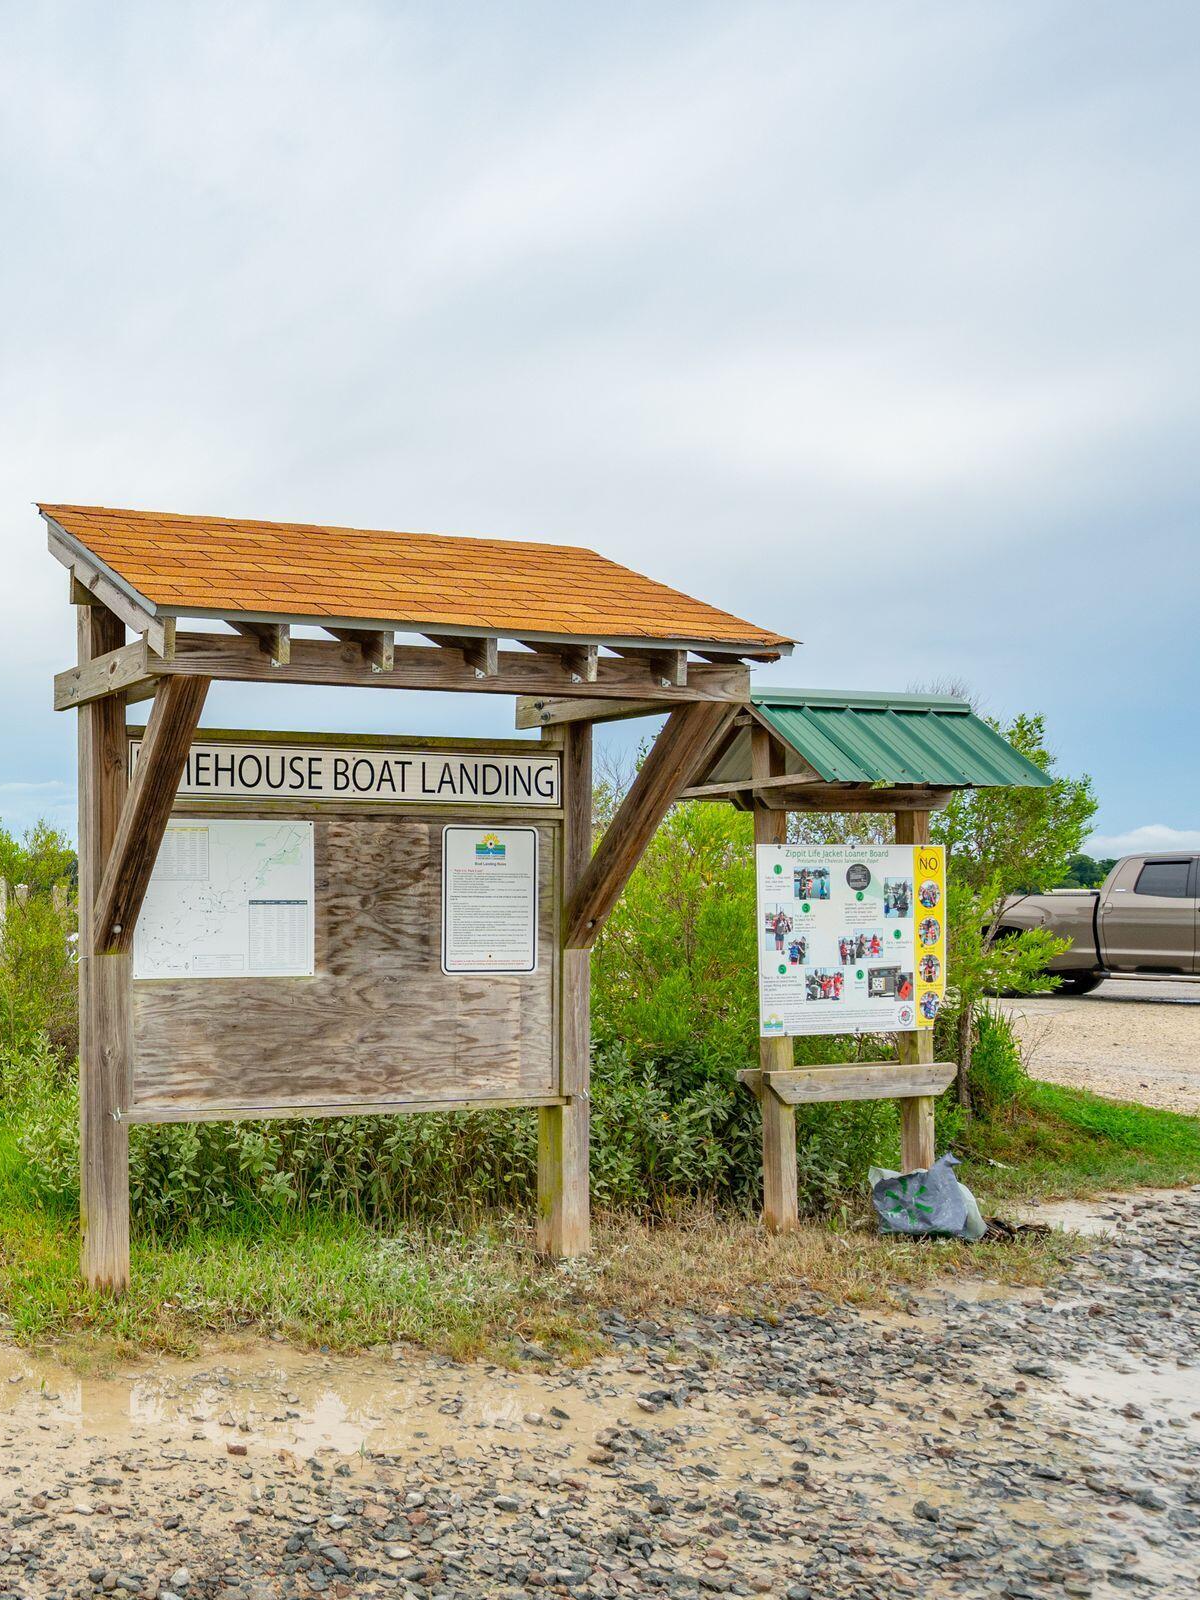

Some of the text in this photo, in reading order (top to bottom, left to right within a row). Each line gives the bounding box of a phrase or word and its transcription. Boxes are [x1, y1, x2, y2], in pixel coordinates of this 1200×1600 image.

[137, 749, 554, 798] EHOUSE BOAT LANDING
[785, 849, 889, 859] Zippit Life Jacket Loaner Board
[920, 857, 937, 870] NO
